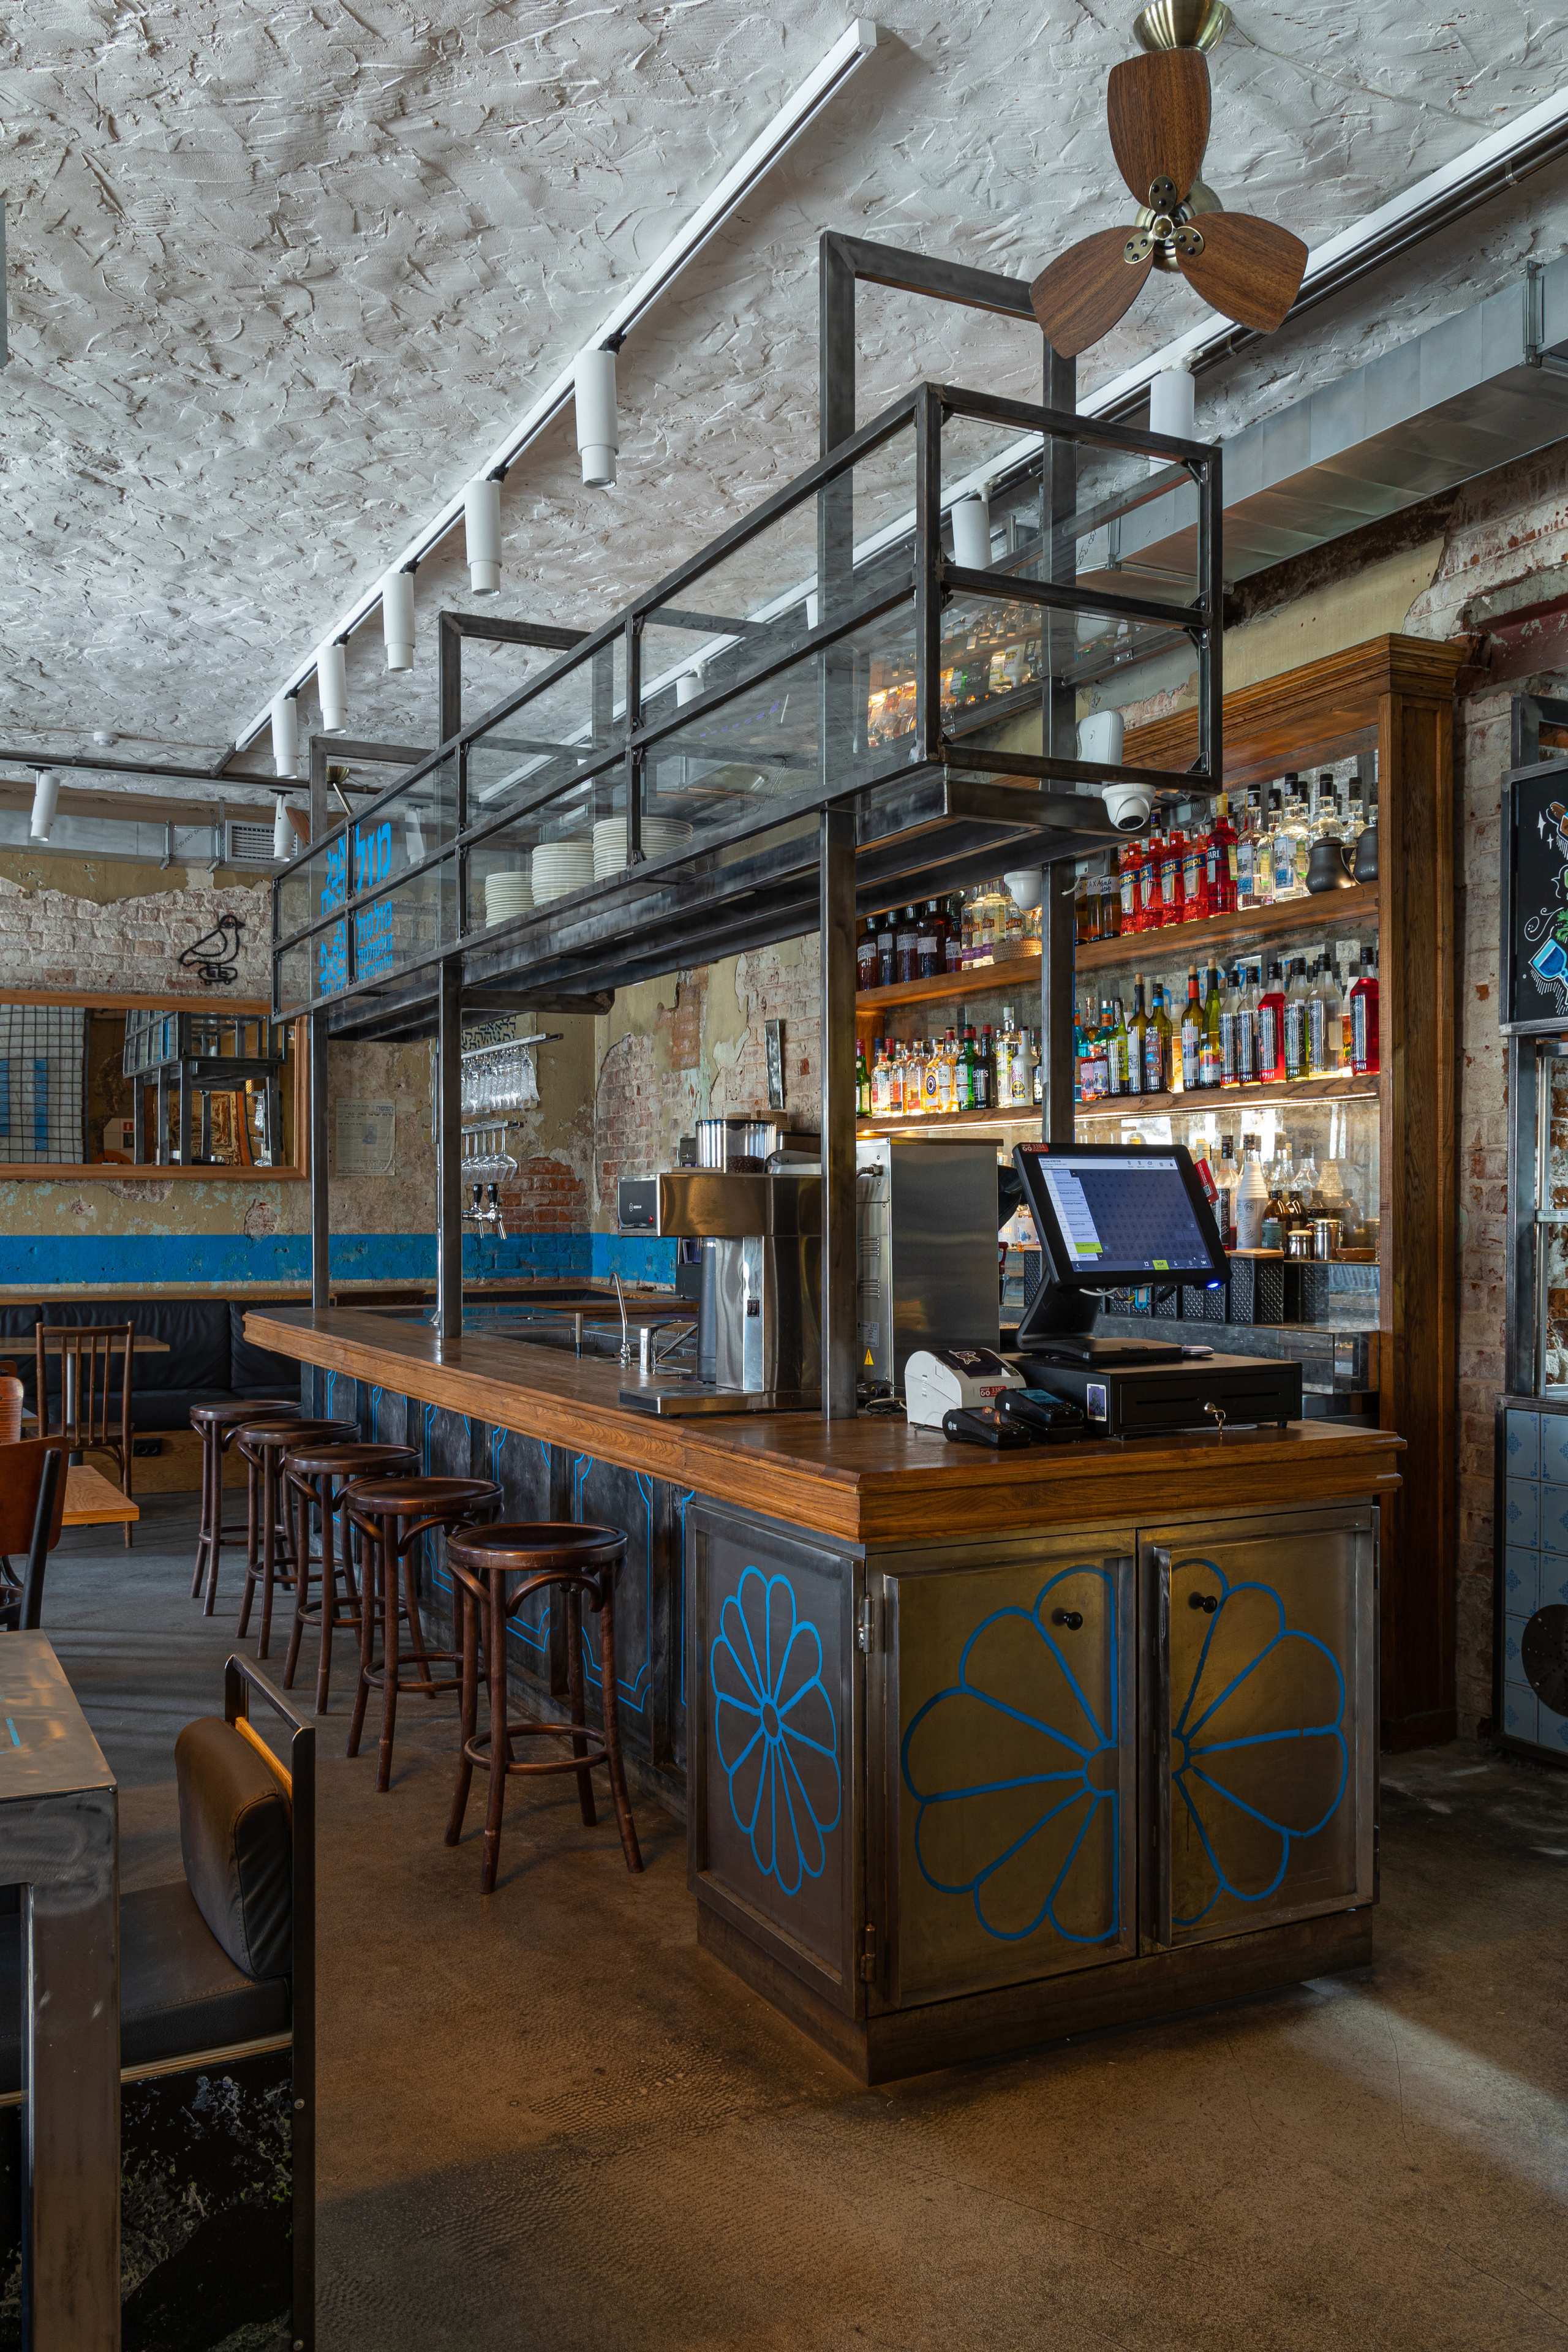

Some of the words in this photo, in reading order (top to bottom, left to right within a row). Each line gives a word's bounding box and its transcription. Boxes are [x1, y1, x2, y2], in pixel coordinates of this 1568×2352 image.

[355, 822, 391, 894] מזל
[356, 911, 373, 944] מזל
[374, 900, 392, 935] מזל
[357, 945, 369, 967] מזל
[369, 939, 380, 961] מזל
[380, 932, 392, 955] מזל
